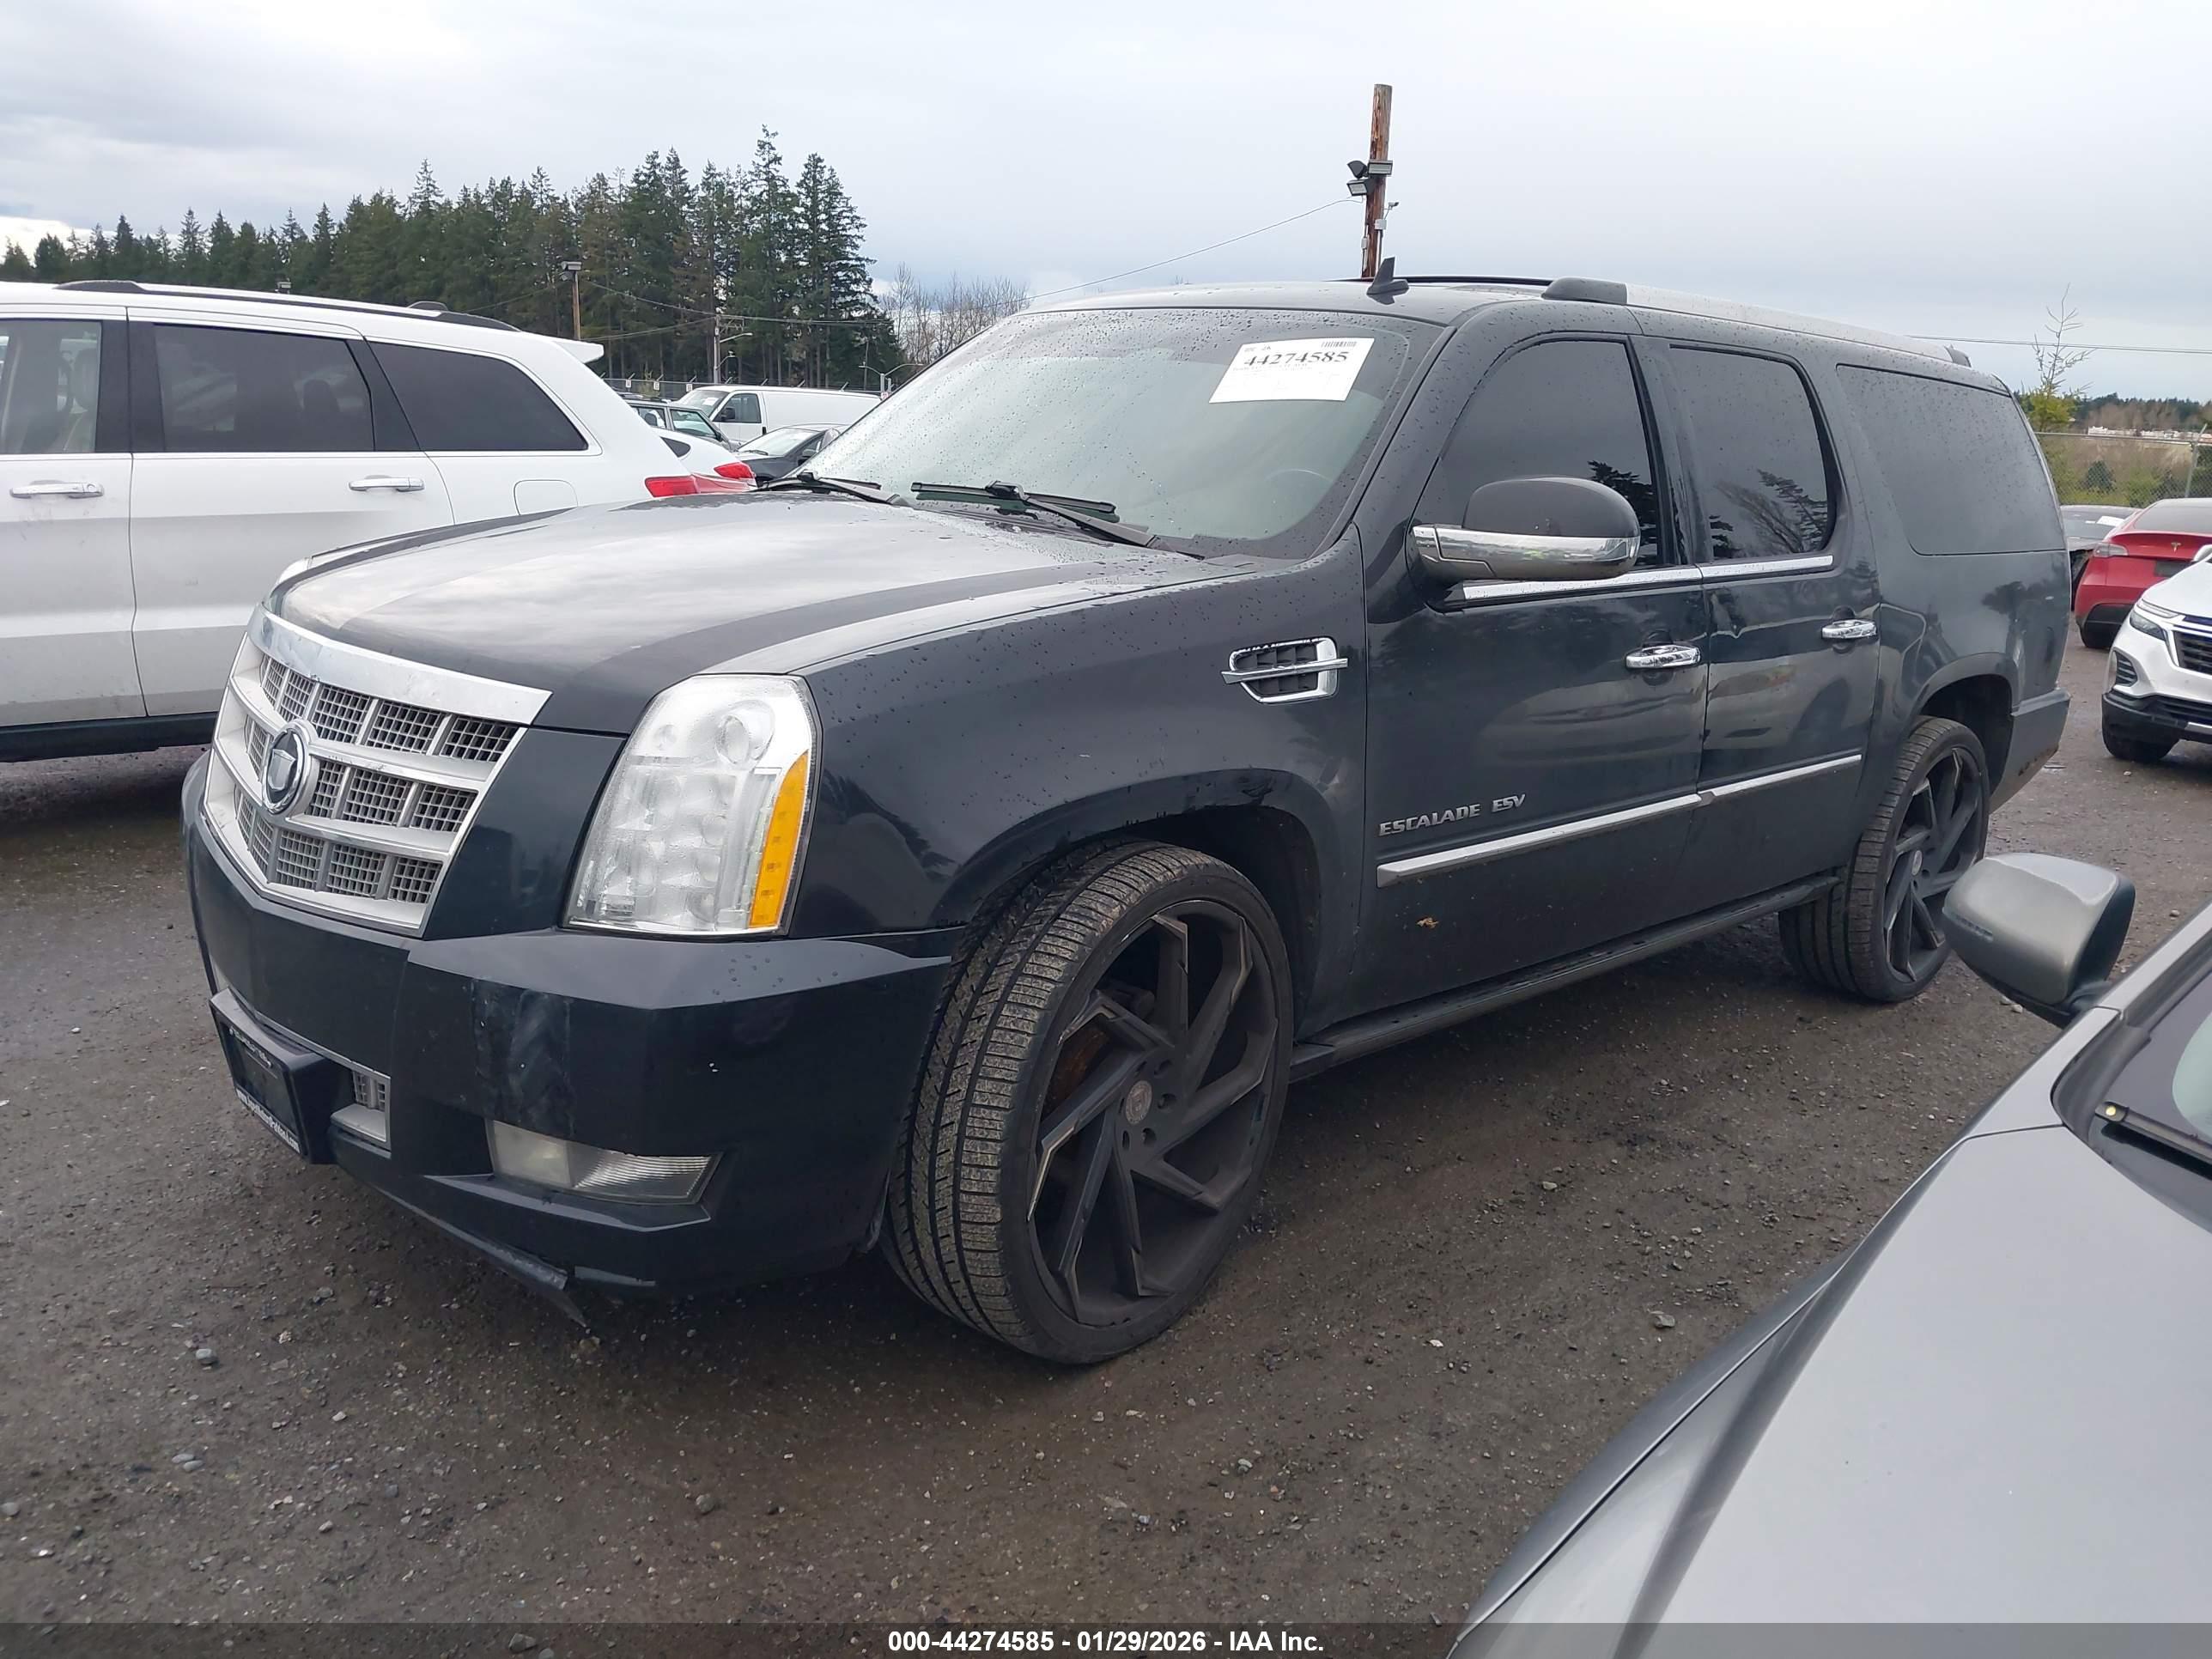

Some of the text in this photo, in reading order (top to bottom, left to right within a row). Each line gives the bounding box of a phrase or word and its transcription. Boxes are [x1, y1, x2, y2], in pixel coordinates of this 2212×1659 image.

[1244, 351, 1349, 367] 44274585
[1379, 793, 1526, 836] ESCALADE ESV
